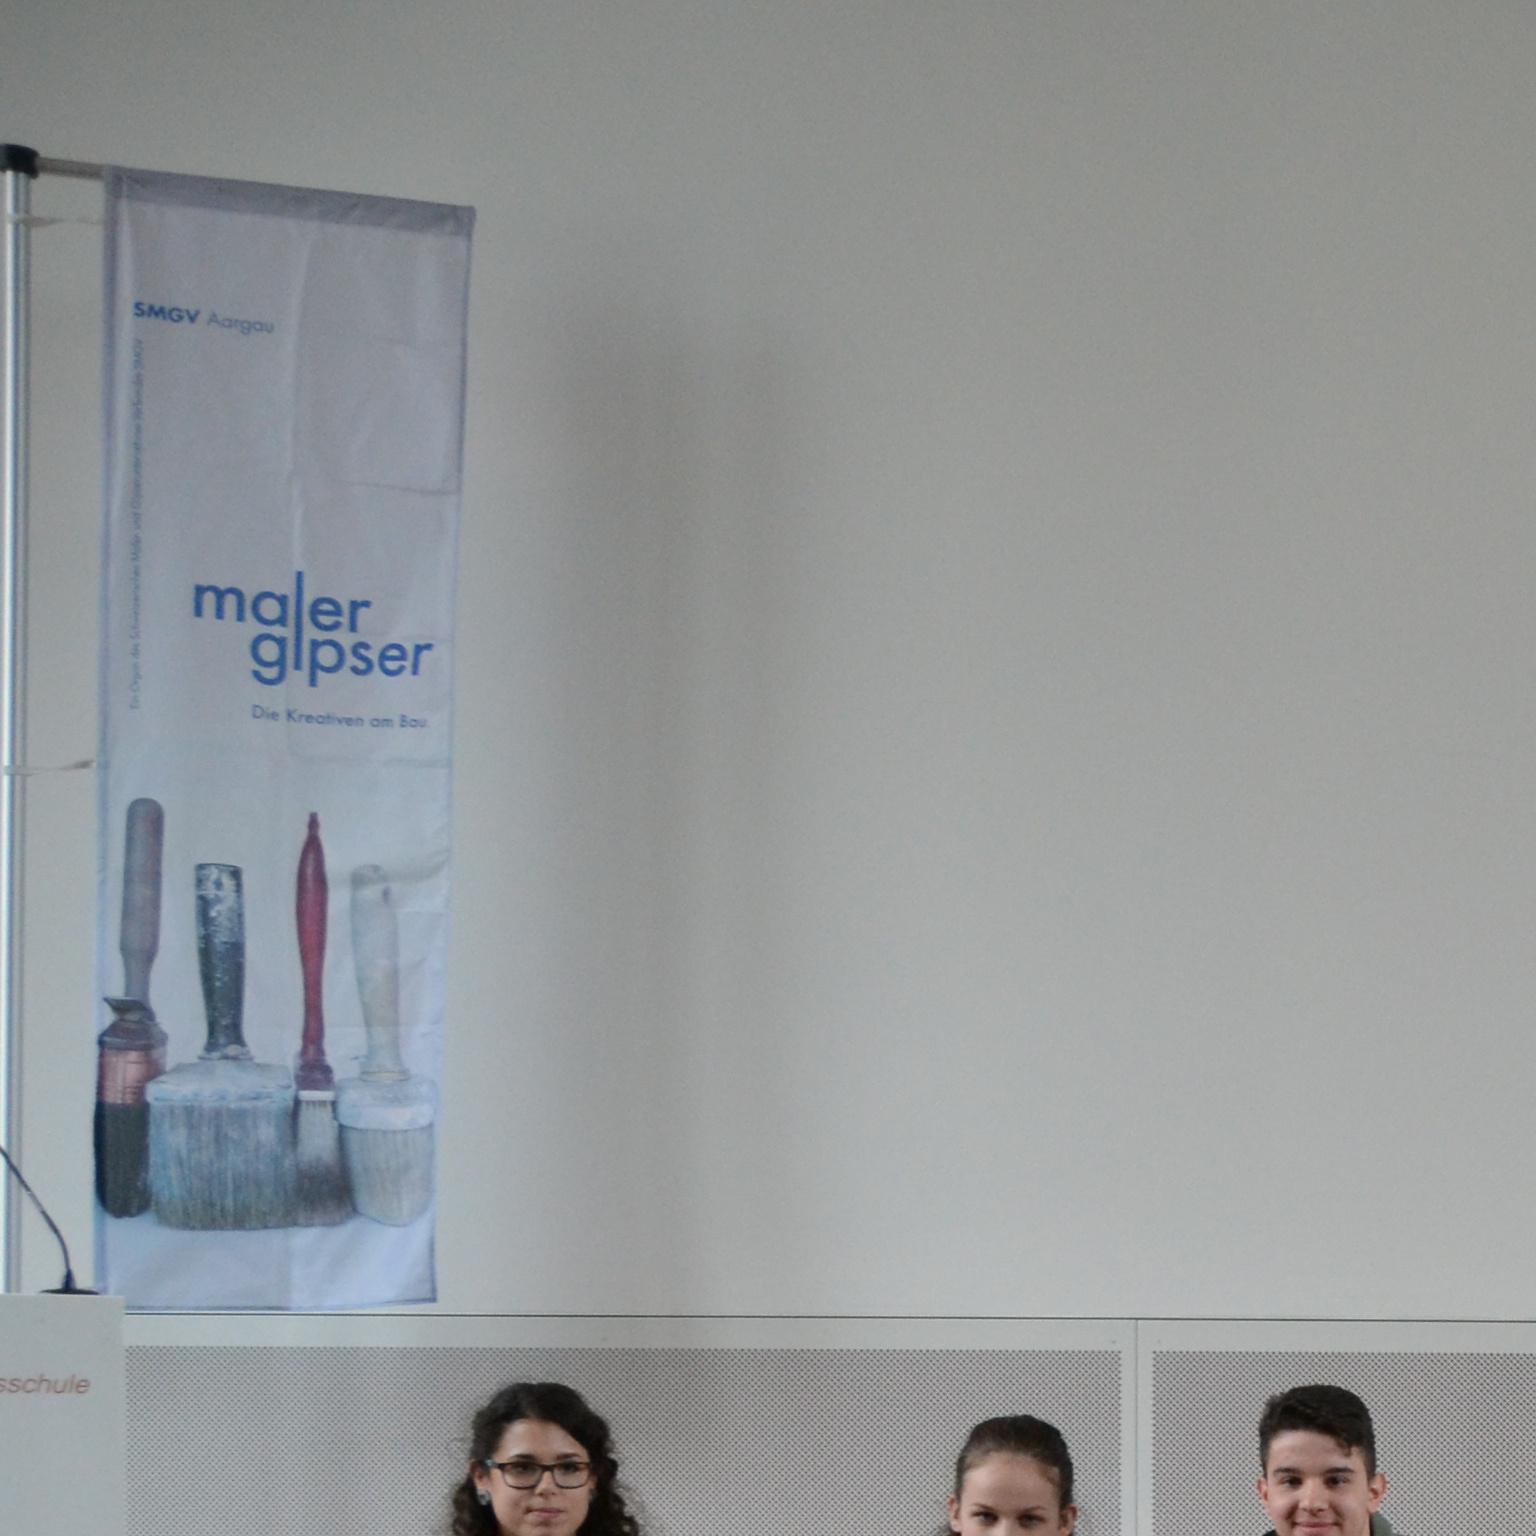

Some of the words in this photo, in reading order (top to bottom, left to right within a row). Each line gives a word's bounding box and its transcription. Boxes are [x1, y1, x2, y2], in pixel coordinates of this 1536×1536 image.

[133, 301, 200, 323] SMGV
[207, 312, 274, 335] Aargau
[193, 571, 371, 633] maler
[250, 632, 434, 687] gipser
[251, 704, 279, 721] Die
[286, 708, 364, 727] Kreativen
[369, 717, 393, 728] am
